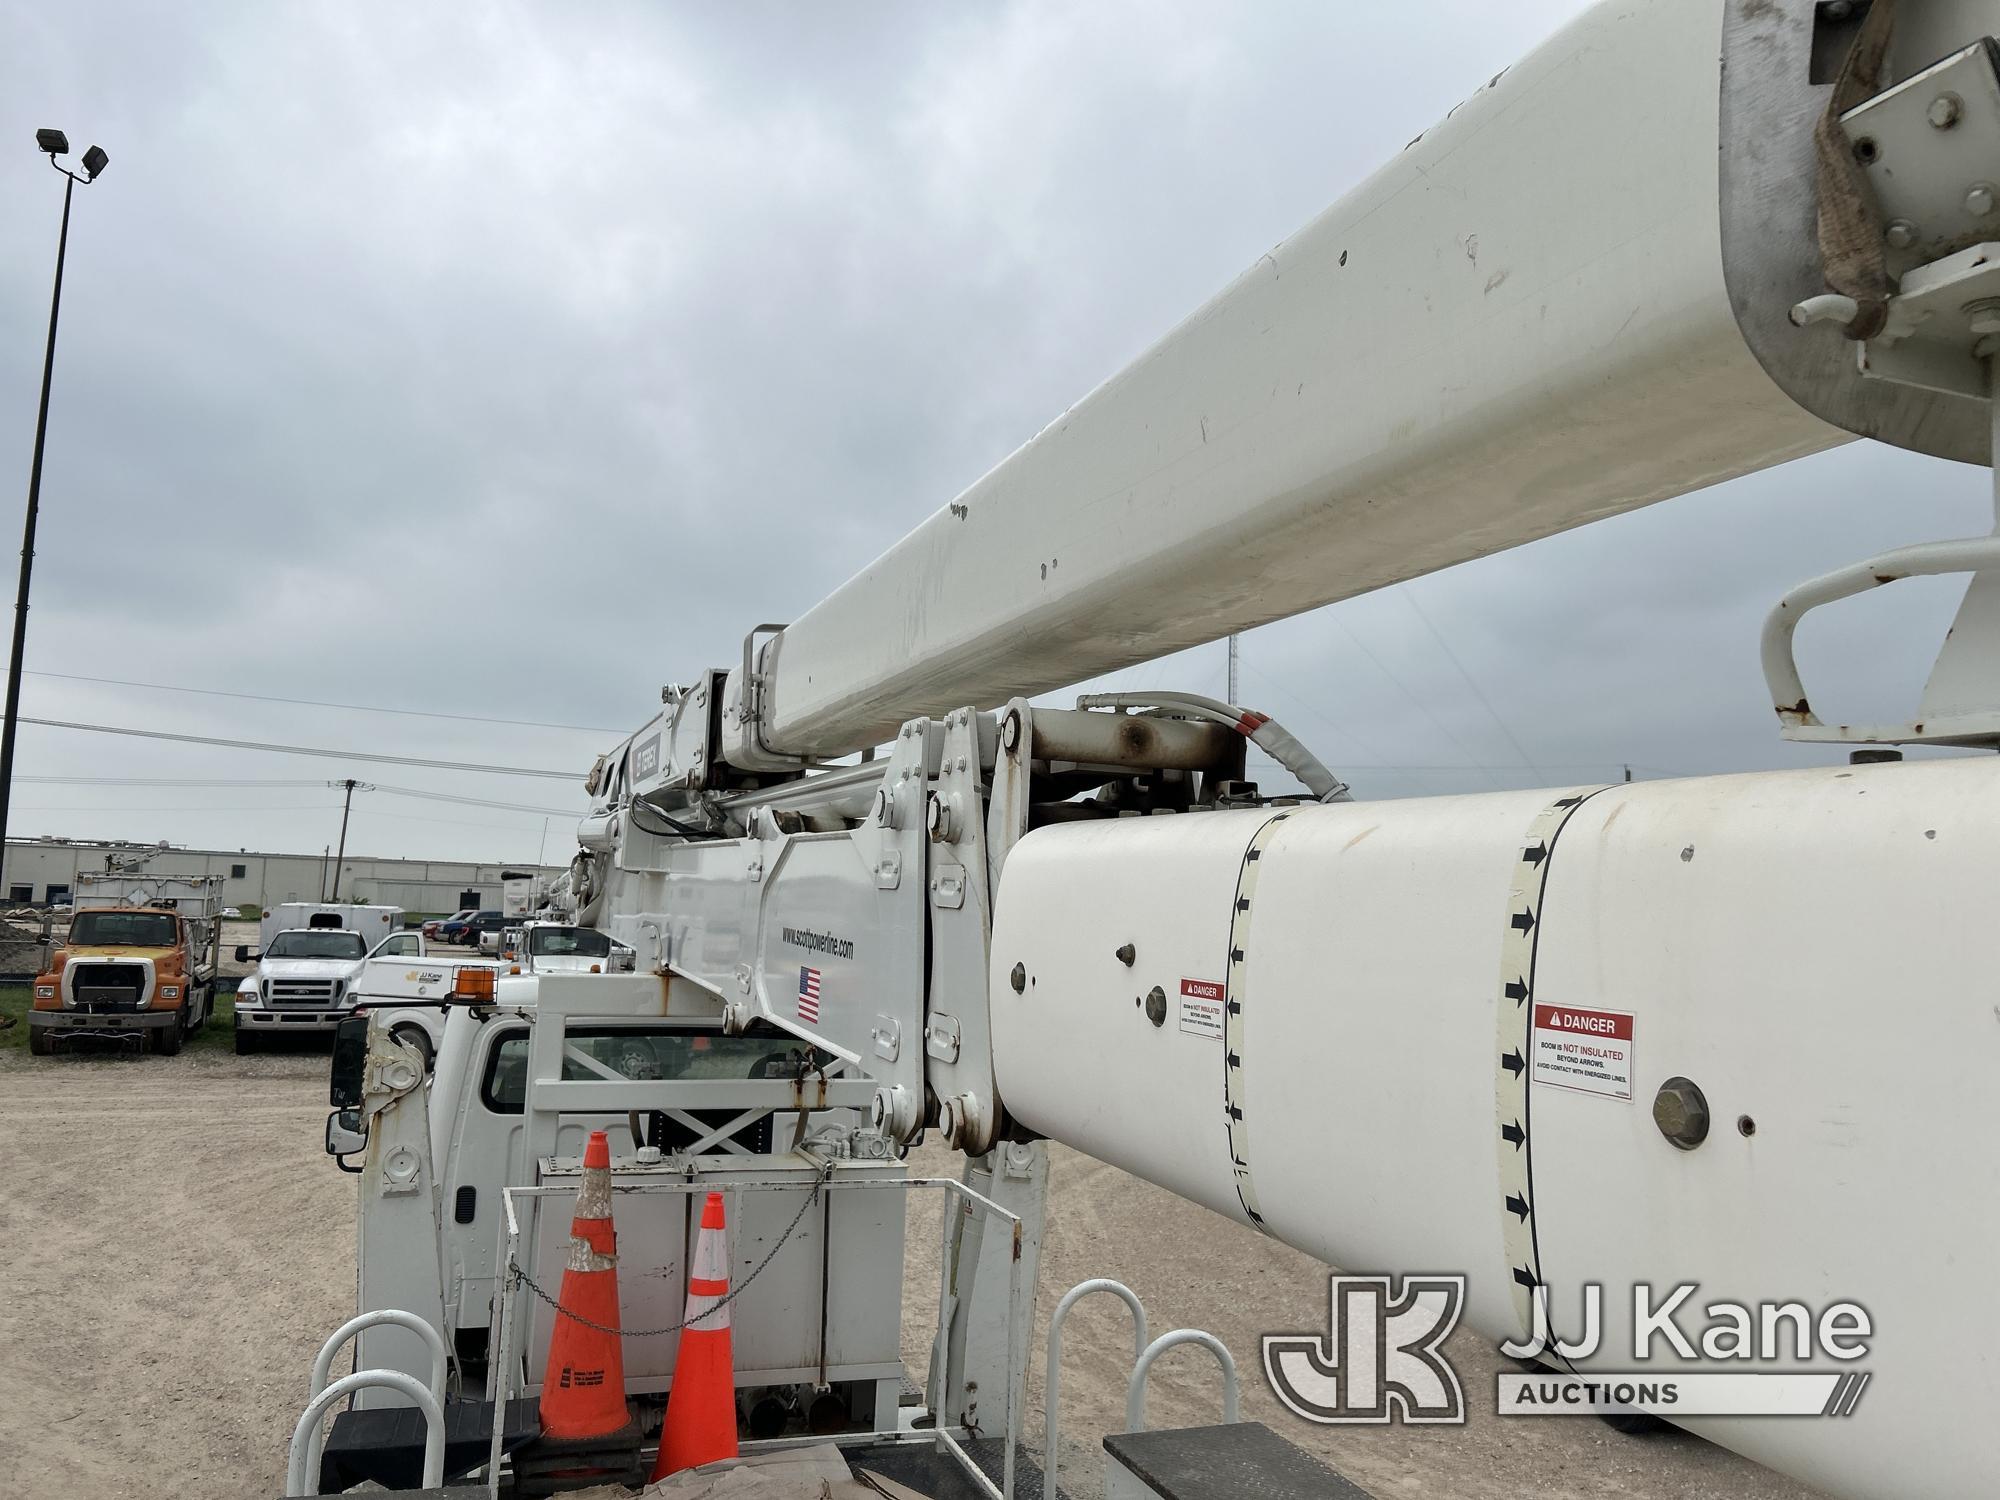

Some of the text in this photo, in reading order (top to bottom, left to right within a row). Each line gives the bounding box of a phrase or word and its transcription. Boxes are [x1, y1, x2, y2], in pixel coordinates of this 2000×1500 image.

[782, 927, 854, 961] www.scottpowerline.com
[1193, 985, 1217, 998] DANGER
[1563, 1014, 1615, 1034] DANGER
[1541, 1041, 1556, 1050] BOOM
[1563, 1043, 1579, 1054] NOT
[1580, 1046, 1624, 1061] INSULATED
[1557, 1054, 1578, 1064] BEYOND
[1537, 1062, 1551, 1070] AVOID
[1551, 1064, 1571, 1073] CONTACT
[1584, 1070, 1611, 1080] ENERGIZED
